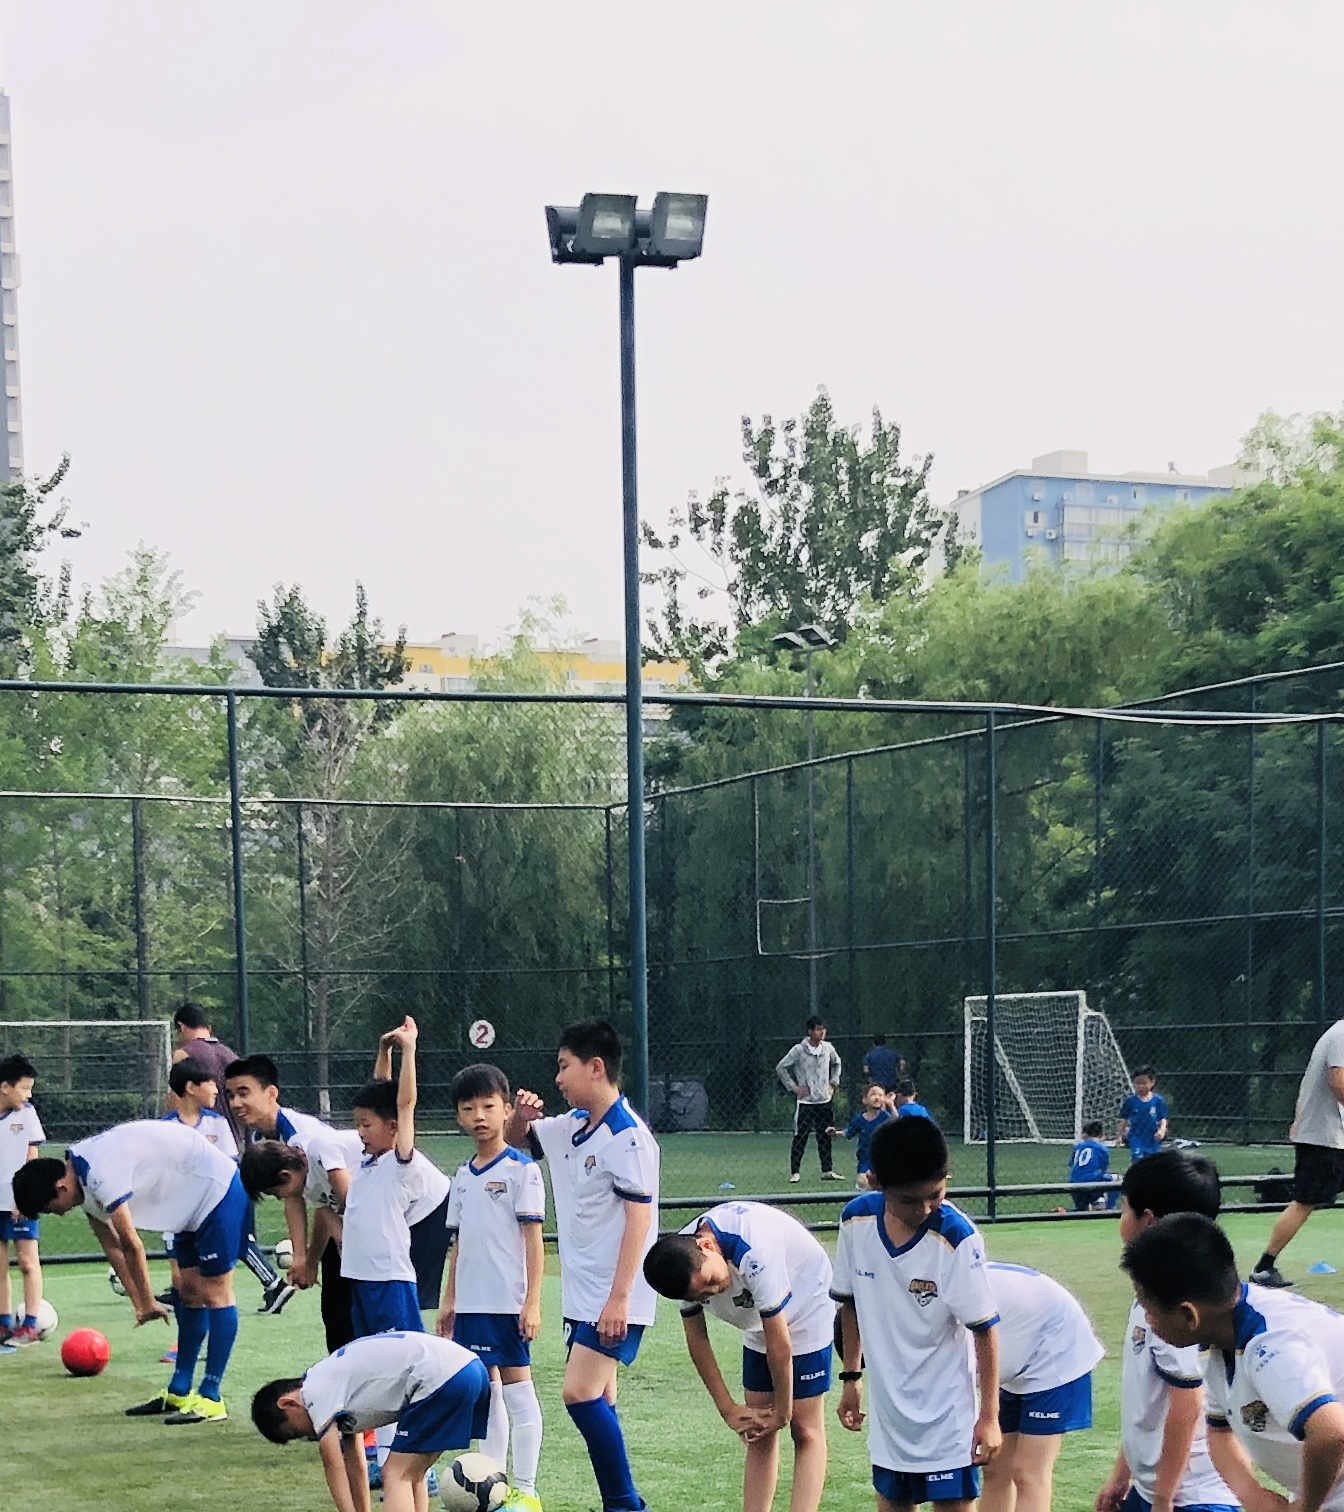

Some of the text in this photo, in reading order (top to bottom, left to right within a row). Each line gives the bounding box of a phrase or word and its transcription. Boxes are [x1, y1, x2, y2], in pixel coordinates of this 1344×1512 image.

[476, 1024, 488, 1044] 2
[1073, 1147, 1092, 1167] 10
[926, 1472, 954, 1482] ELME
